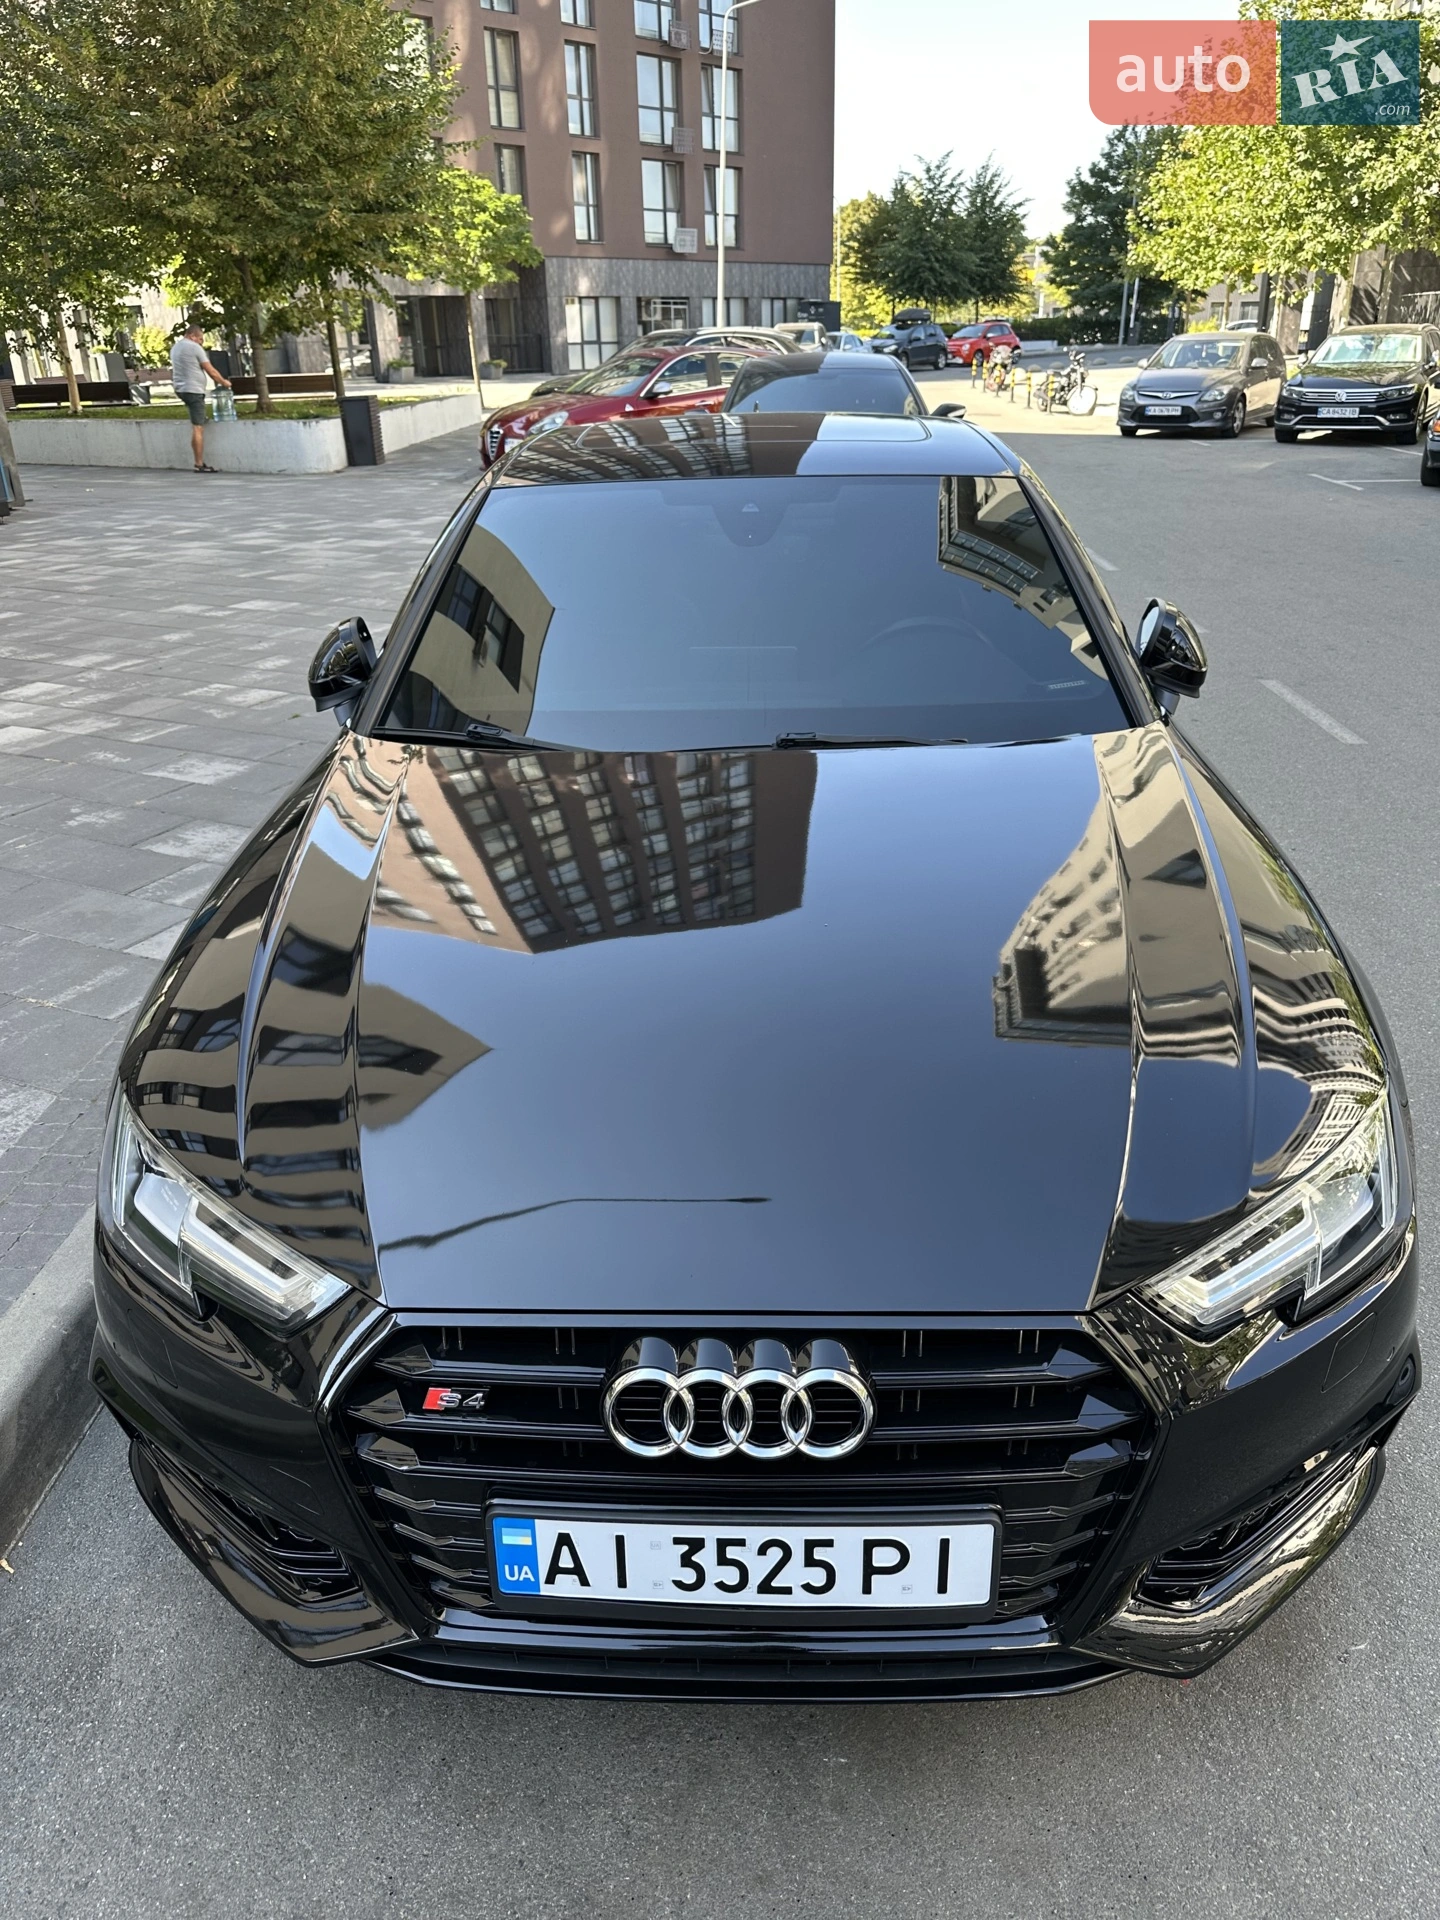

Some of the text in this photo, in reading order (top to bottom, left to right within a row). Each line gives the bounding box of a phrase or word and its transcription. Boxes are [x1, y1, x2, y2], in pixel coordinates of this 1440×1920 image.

[437, 1392, 485, 1409] S4
[504, 1564, 535, 1582] UA
[544, 1532, 951, 1596] AI 3525 PI
